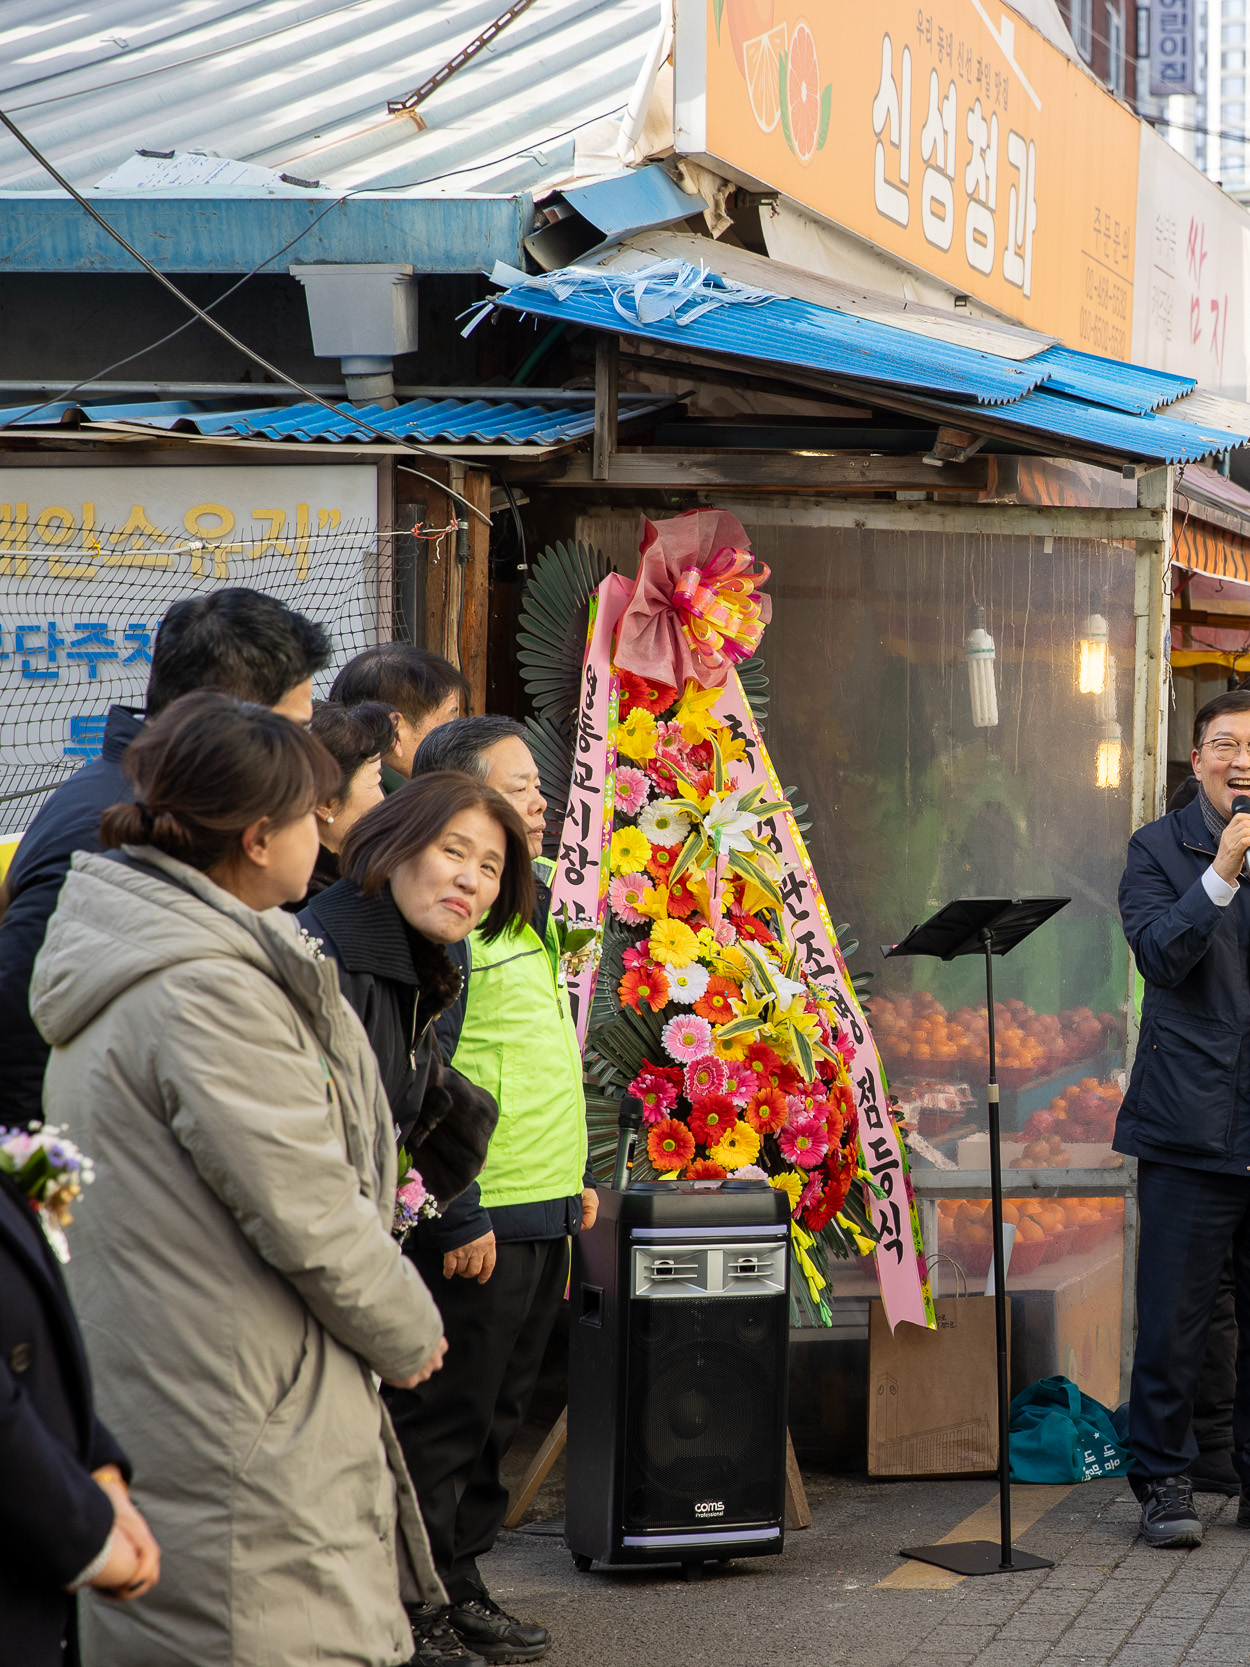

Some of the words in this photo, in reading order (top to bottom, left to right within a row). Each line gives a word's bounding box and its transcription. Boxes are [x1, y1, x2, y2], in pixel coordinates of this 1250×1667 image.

[916, 9, 933, 55] 우리
[937, 25, 954, 71] 동네
[957, 41, 973, 85] 신선
[976, 56, 992, 101] 과일
[994, 71, 1010, 112] 맛집
[871, 31, 1038, 299] 신성청과
[857, 1066, 904, 1265] 점등식
